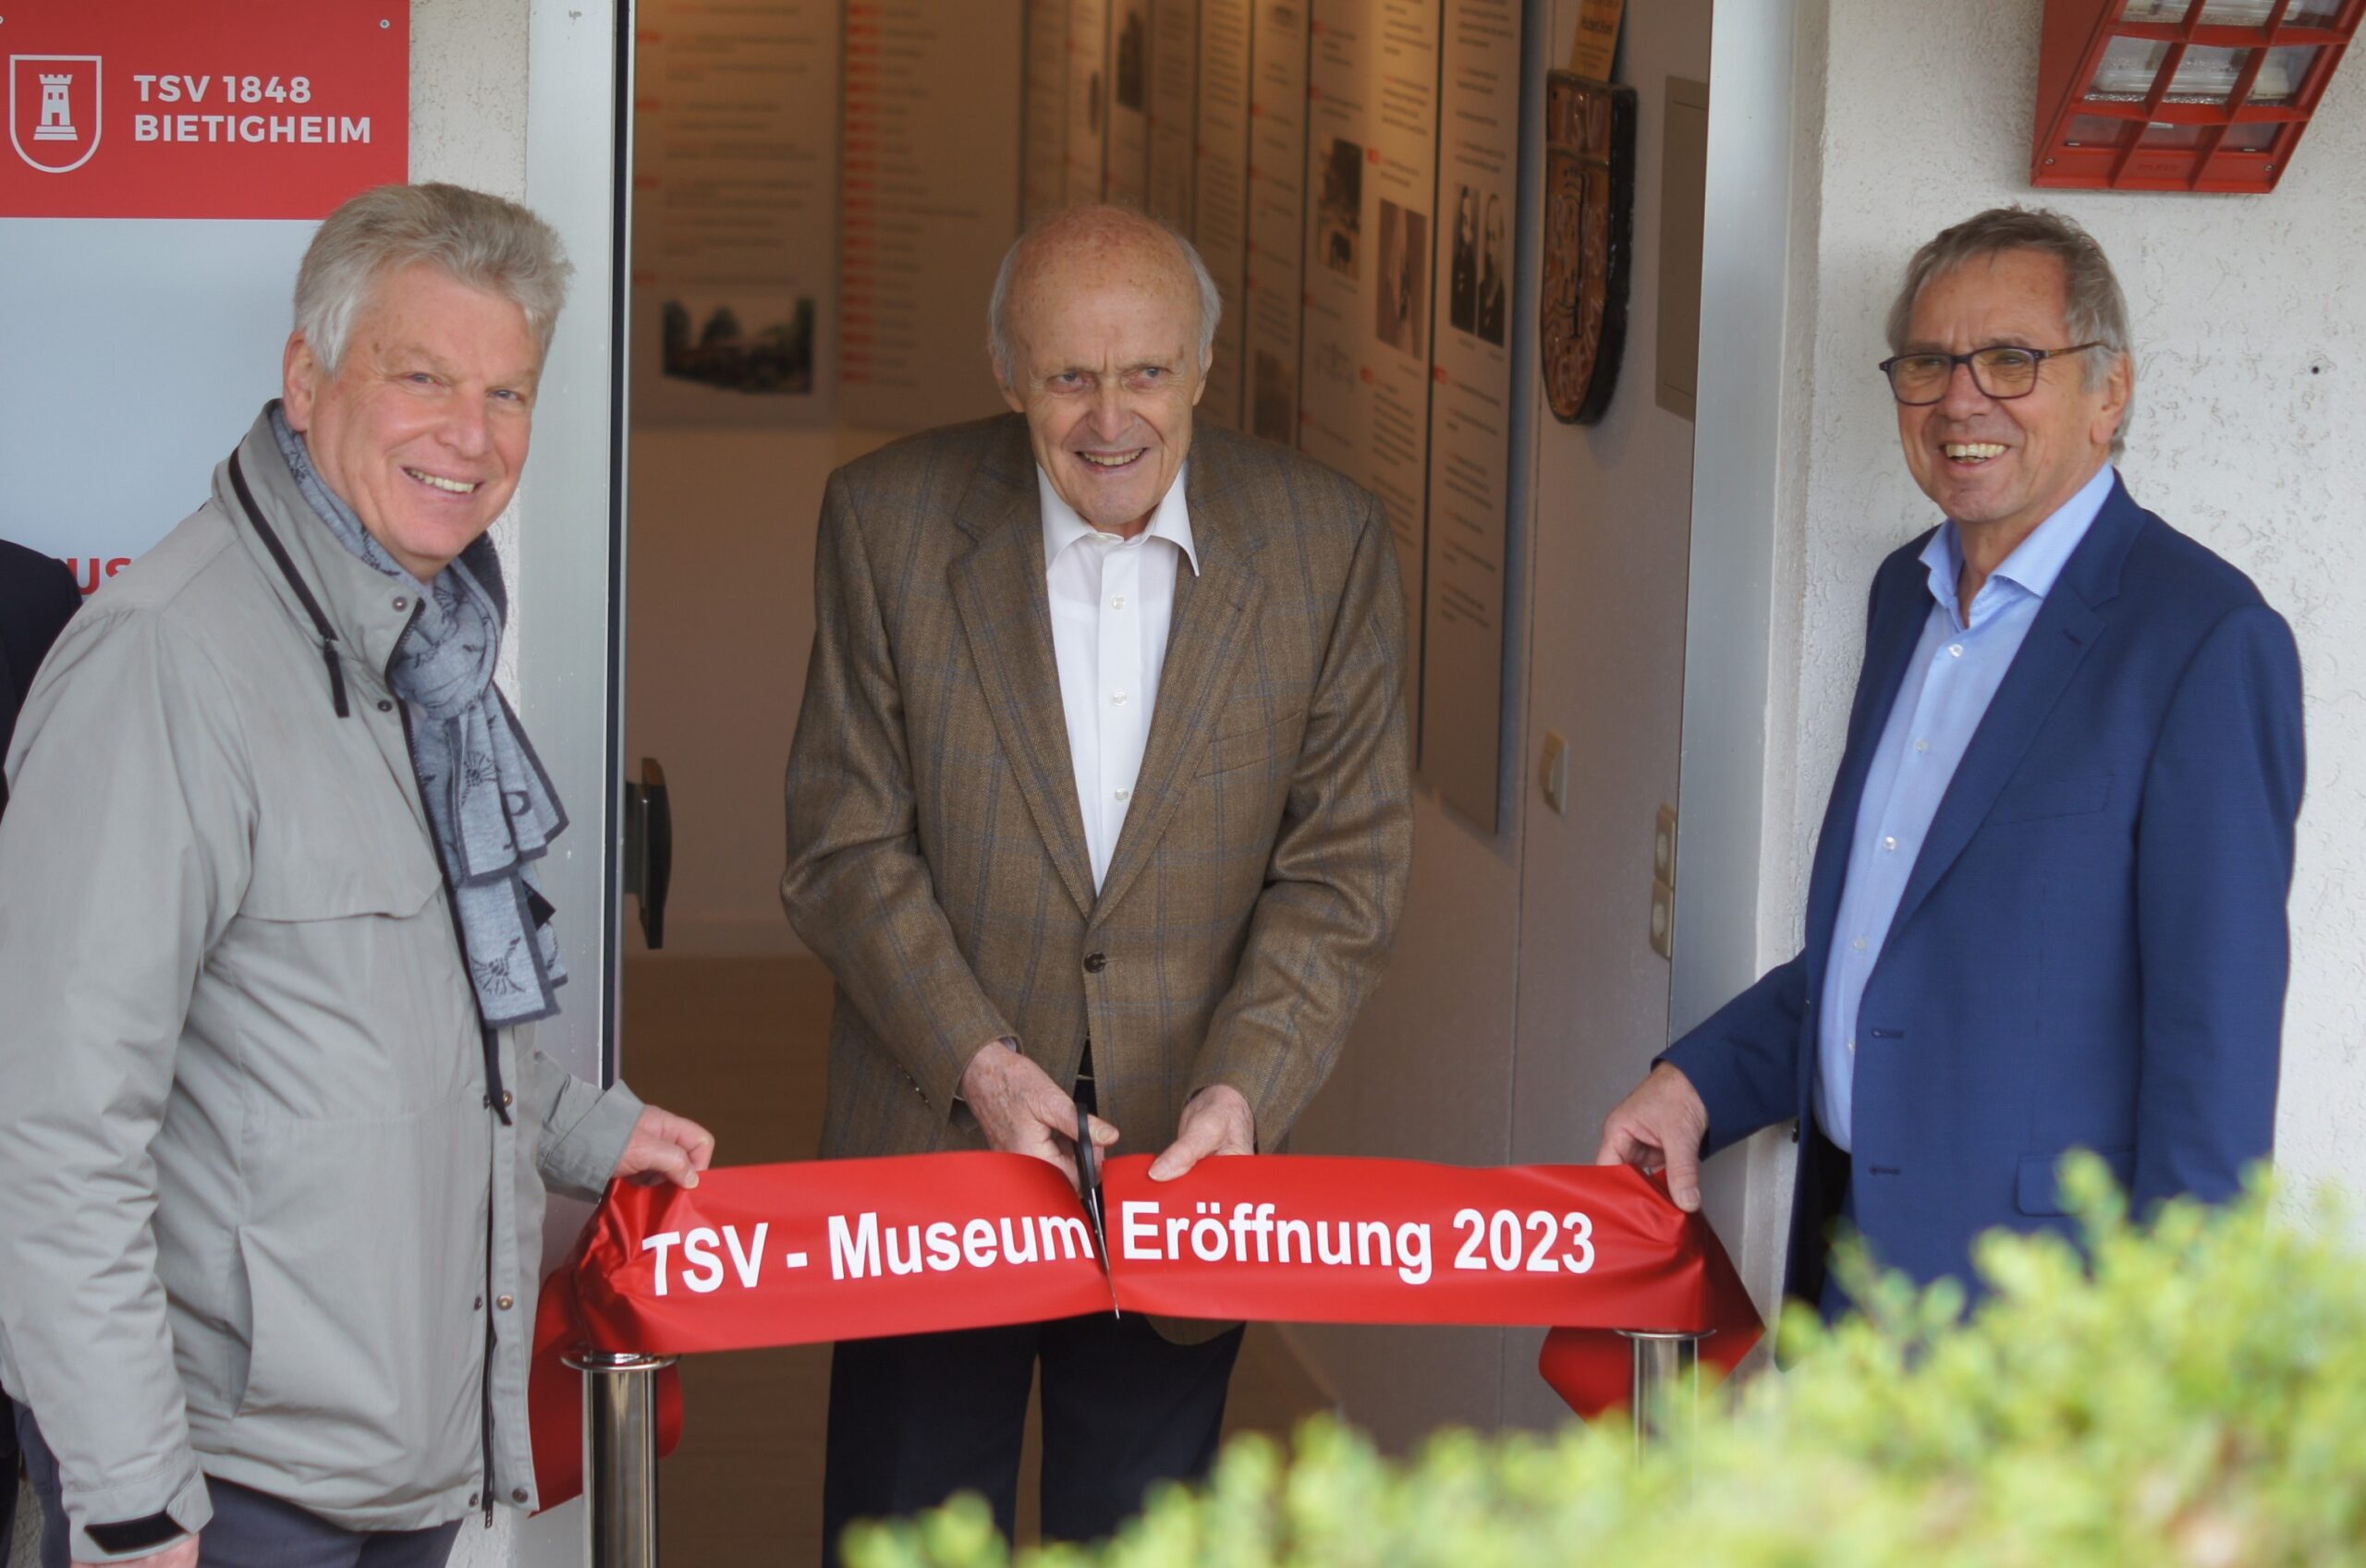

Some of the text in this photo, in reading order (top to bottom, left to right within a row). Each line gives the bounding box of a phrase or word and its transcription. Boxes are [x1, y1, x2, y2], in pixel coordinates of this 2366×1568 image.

[133, 75, 311, 103] TSV 1848
[134, 115, 372, 143] BIETIGHEIM
[640, 1222, 769, 1296] TSV
[827, 1211, 1095, 1281] Museum
[1121, 1200, 1433, 1285] Eröffnung
[1453, 1208, 1596, 1274] 2023
